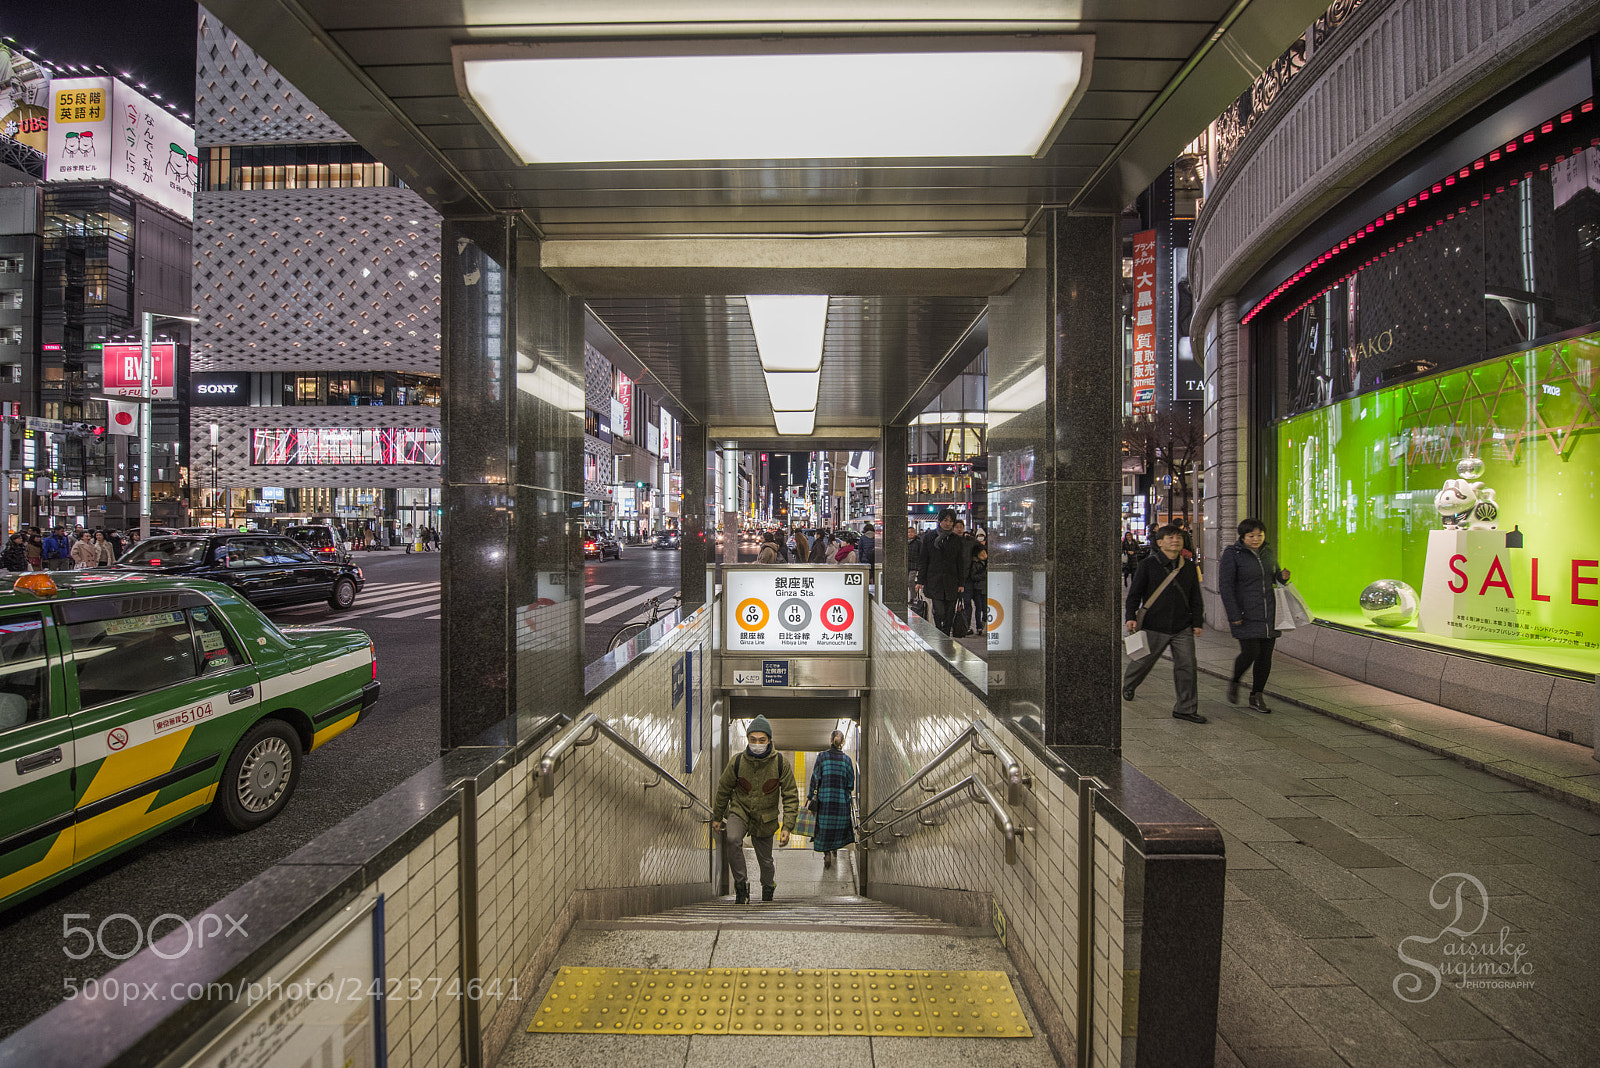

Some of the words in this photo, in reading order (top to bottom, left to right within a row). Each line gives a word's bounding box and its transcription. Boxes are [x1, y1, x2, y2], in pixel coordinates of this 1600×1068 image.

[60, 92, 101, 106] 55段階
[60, 106, 100, 120] 英語村
[19, 116, 48, 133] UBS
[1134, 240, 1156, 252] ブランド
[1134, 255, 1155, 267] チケット
[1136, 271, 1153, 327] 大黒屋
[1136, 332, 1152, 350] 質
[198, 384, 238, 394] SONY
[774, 577, 815, 589] 銀座駅
[846, 574, 862, 584] A9
[1448, 554, 1599, 606] SALE
[748, 606, 756, 614] G
[791, 606, 798, 614] H
[832, 606, 841, 614] M
[746, 614, 759, 622] 09
[788, 614, 801, 622] 08
[831, 614, 844, 622] 16
[740, 632, 765, 640] 銀座線
[778, 632, 810, 640] 日比谷線
[821, 632, 853, 640] 丸ノ内線
[182, 704, 212, 723] 5104
